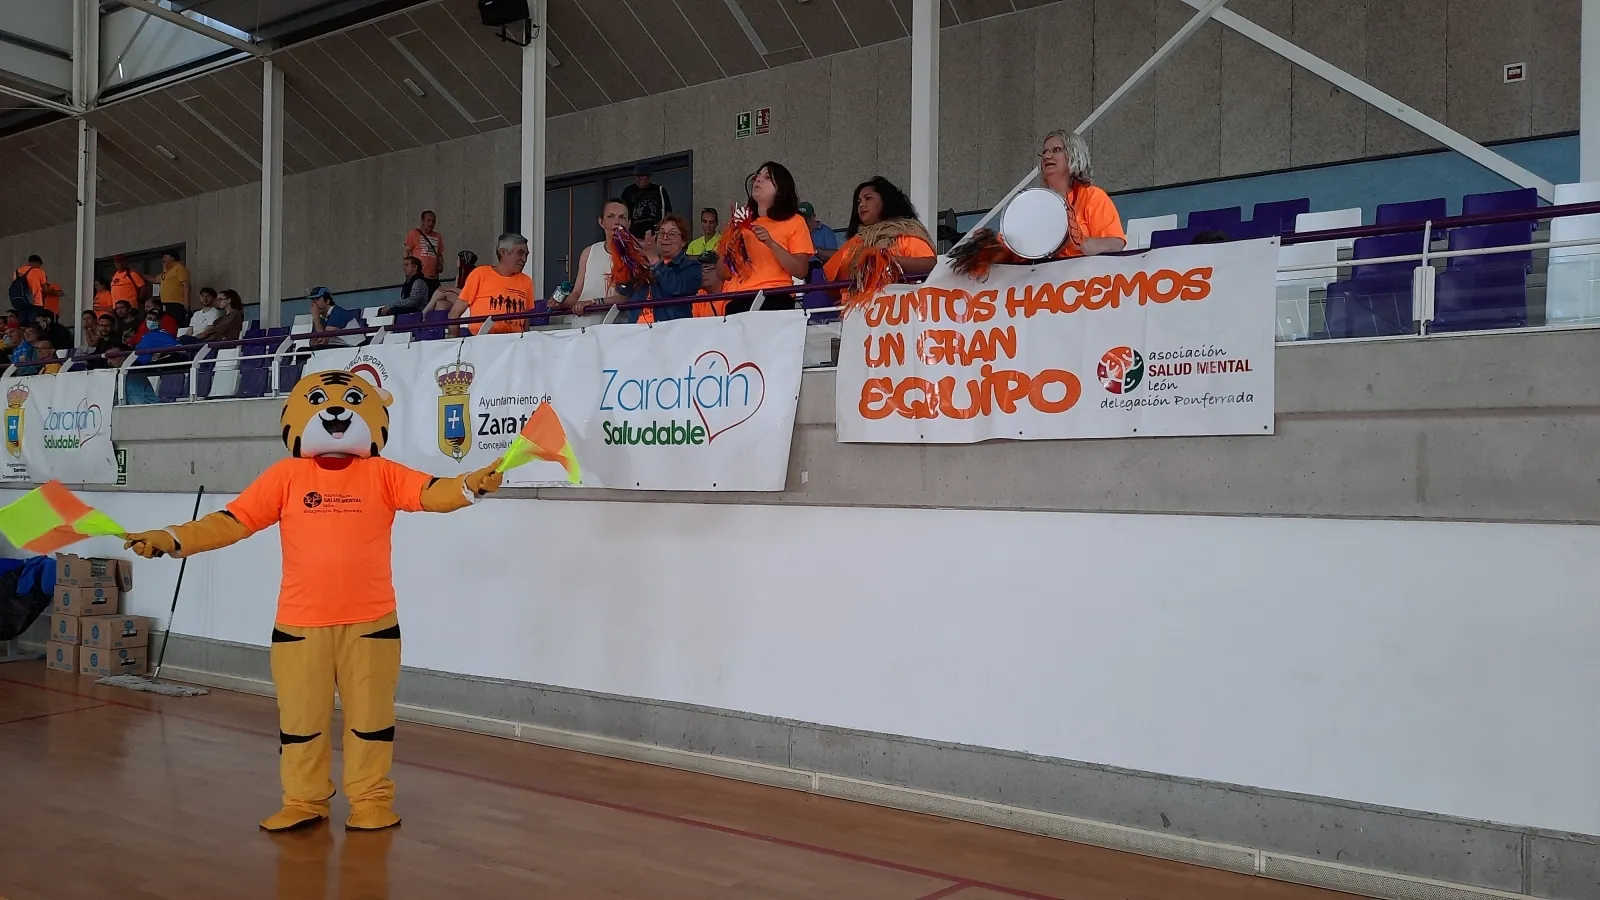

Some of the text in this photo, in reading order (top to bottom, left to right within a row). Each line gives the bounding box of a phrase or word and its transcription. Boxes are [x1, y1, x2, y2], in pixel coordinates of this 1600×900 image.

[865, 267, 1213, 328] JUNTOS HACEMOS
[864, 326, 1017, 368] UN GRAN
[1148, 345, 1227, 361] asociación
[1148, 359, 1253, 377] SALUD MENTAL
[600, 360, 749, 411] Zaratán
[479, 392, 552, 409] Ayuntamiento de
[1100, 391, 1254, 411] delegación Ponferrada
[477, 411, 535, 436] Zarat
[602, 419, 706, 445] Saludable
[43, 434, 80, 449] Saludable
